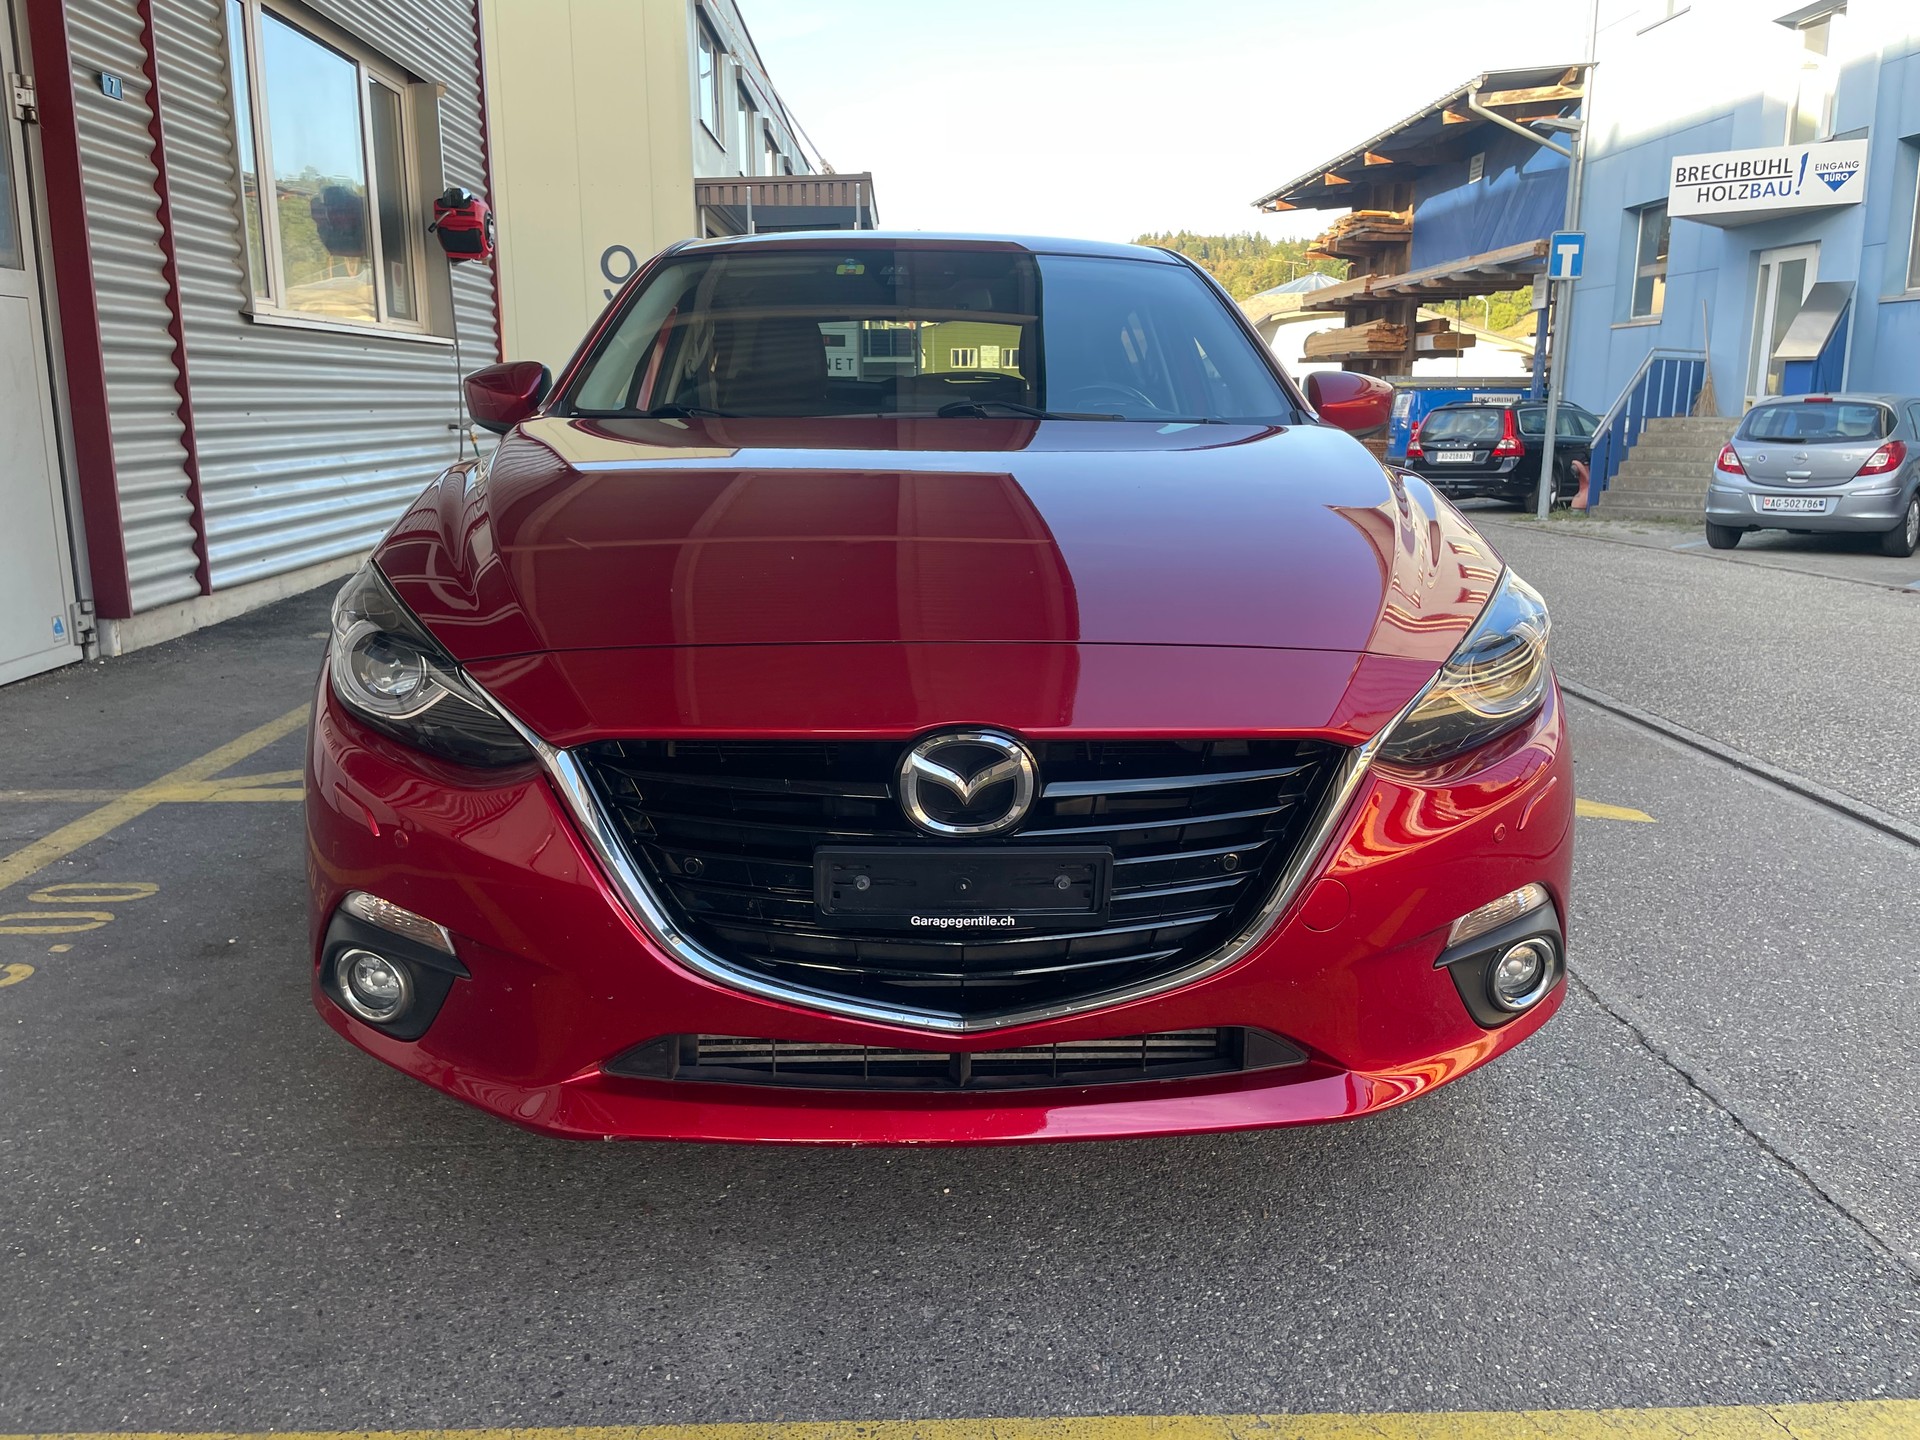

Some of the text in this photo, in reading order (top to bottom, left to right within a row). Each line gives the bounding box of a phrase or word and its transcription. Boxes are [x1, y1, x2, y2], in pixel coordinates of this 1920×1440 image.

[108, 77, 115, 94] 7
[1675, 158, 1793, 183] BRECHBÜHL
[1815, 160, 1860, 171] EINGANG
[1823, 172, 1849, 182] BÜRO
[911, 915, 1015, 928] Garagegentile.ch
